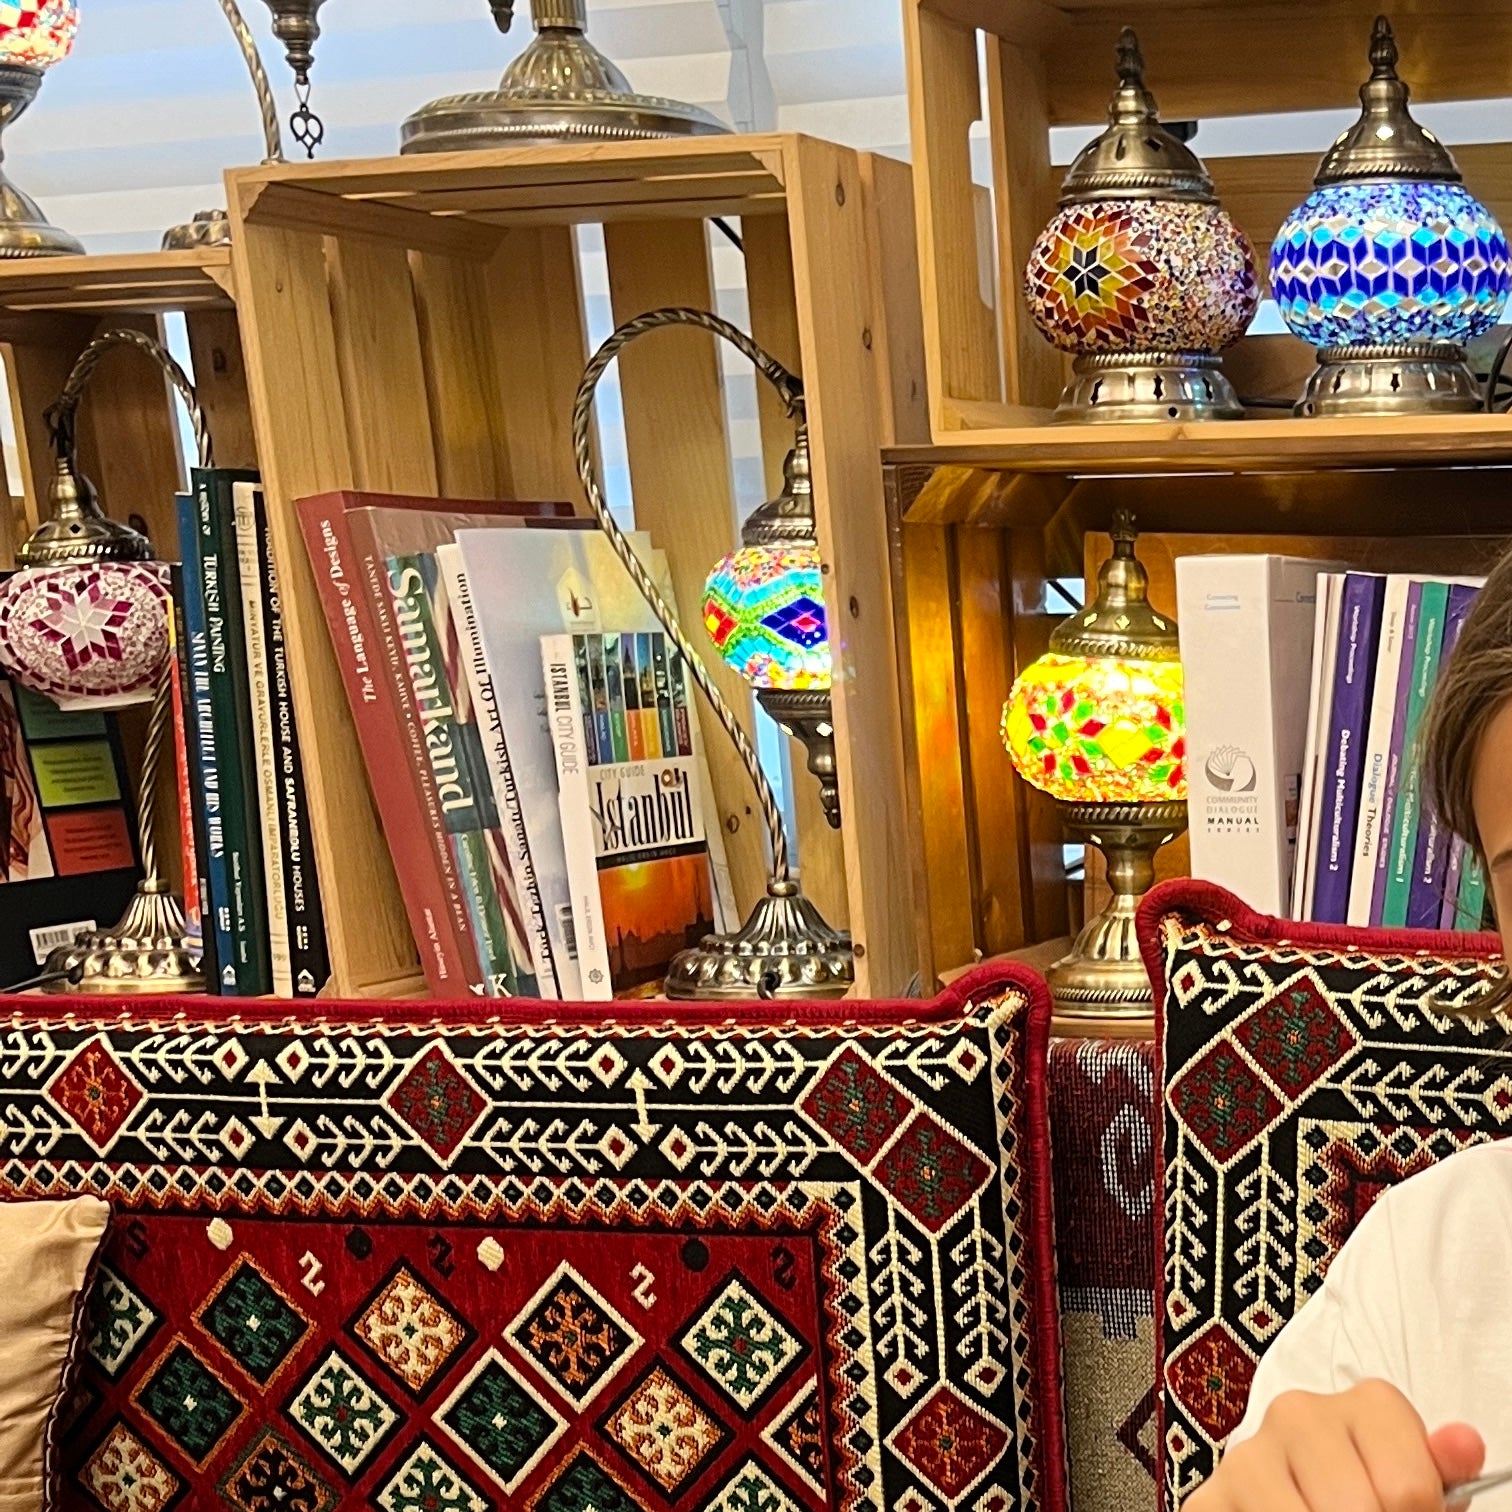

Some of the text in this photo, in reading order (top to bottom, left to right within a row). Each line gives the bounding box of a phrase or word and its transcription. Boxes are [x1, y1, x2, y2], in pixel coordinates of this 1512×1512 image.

[200, 553, 227, 673] TURKISH PAINTING
[269, 595, 281, 613] OF
[316, 517, 377, 702] The Language of Designs
[270, 618, 283, 641] THE
[452, 571, 488, 675] Illumination
[253, 662, 263, 677] VE
[271, 645, 288, 695] TURKISH
[380, 563, 480, 813] Samarkand
[478, 679, 494, 702] Of
[277, 700, 291, 742] HOUSE
[554, 714, 576, 741] CITY
[280, 745, 294, 773] AND
[557, 740, 581, 776] GUIDE
[600, 764, 645, 781] CITY GUIDE
[1206, 806, 1258, 814] DIALOGUE
[1207, 796, 1259, 804] COMMUNITY
[1327, 729, 1351, 871] Debating Multiculturalism 2
[1361, 753, 1383, 858] Dialogue Theories
[1207, 817, 1260, 825] MANUAL
[290, 864, 306, 911] HOUSES
